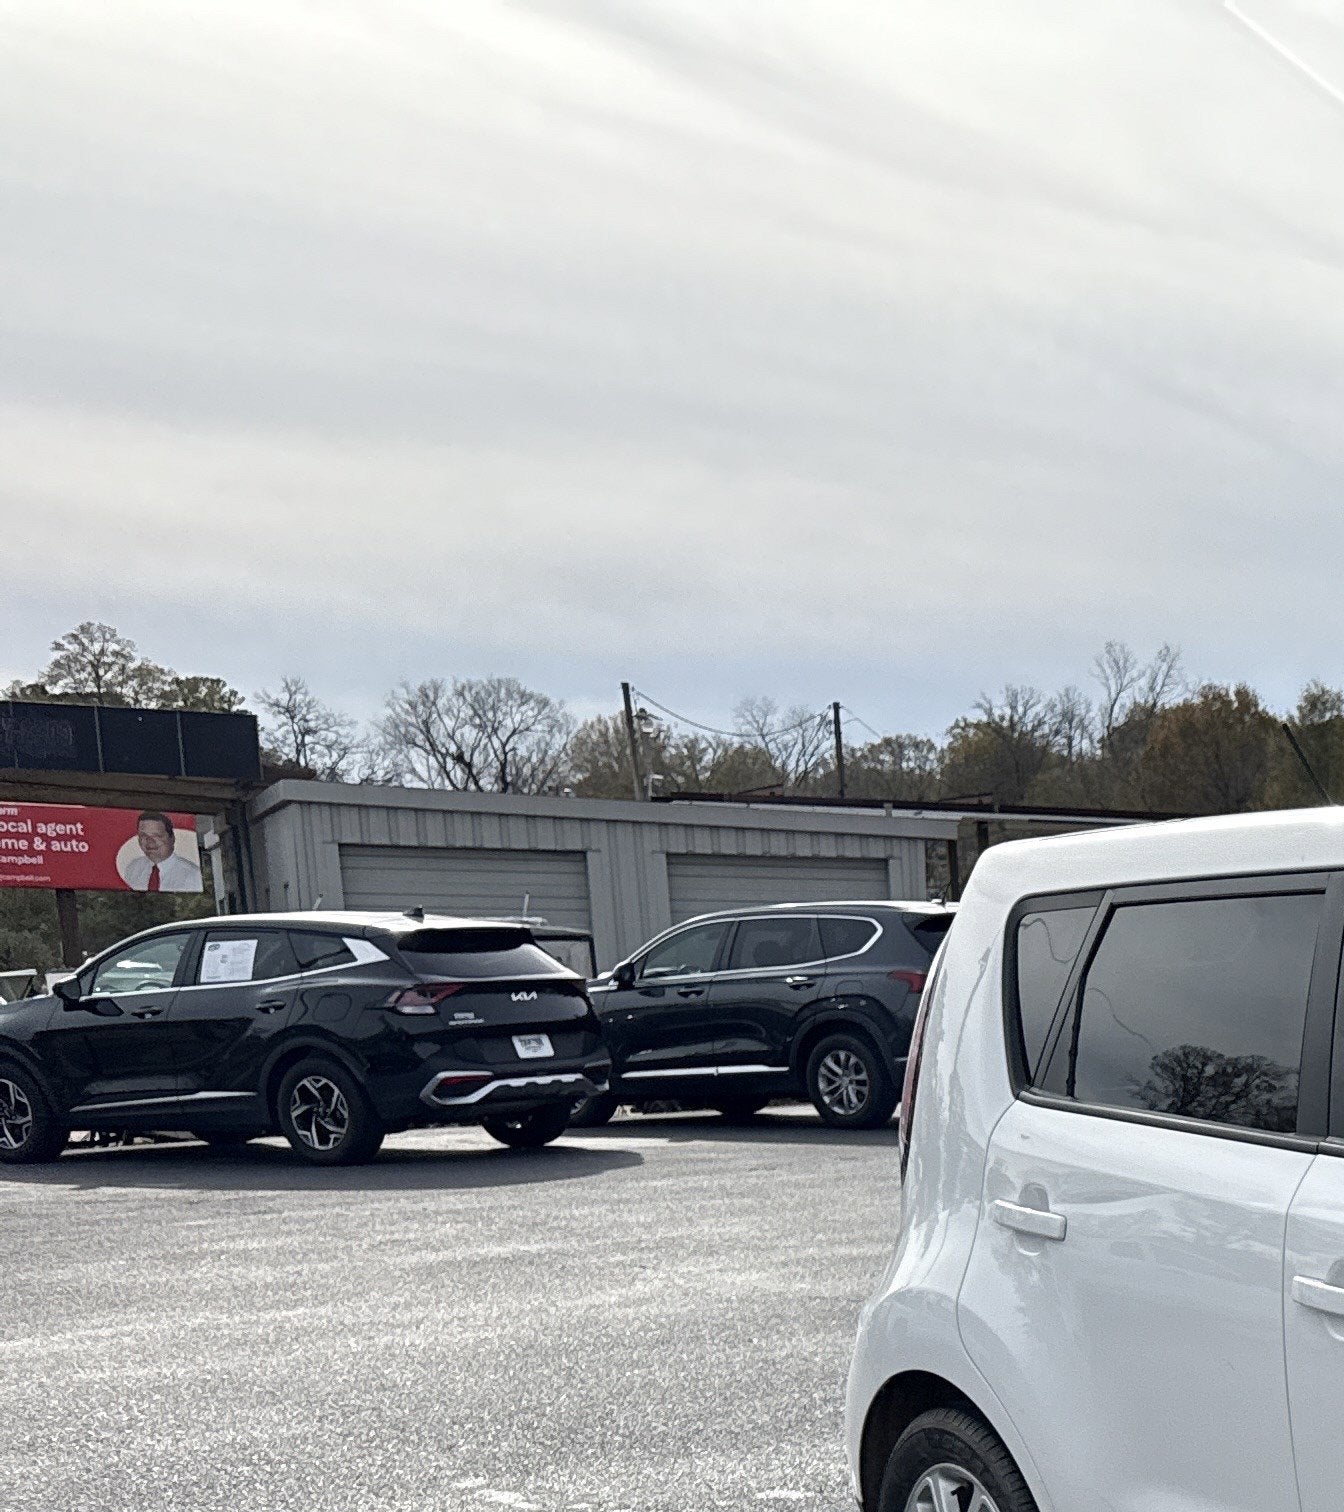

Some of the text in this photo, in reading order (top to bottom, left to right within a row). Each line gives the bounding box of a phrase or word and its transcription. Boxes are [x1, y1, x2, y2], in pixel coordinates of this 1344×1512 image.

[36, 822, 85, 837] agent
[0, 836, 89, 852] me & auto
